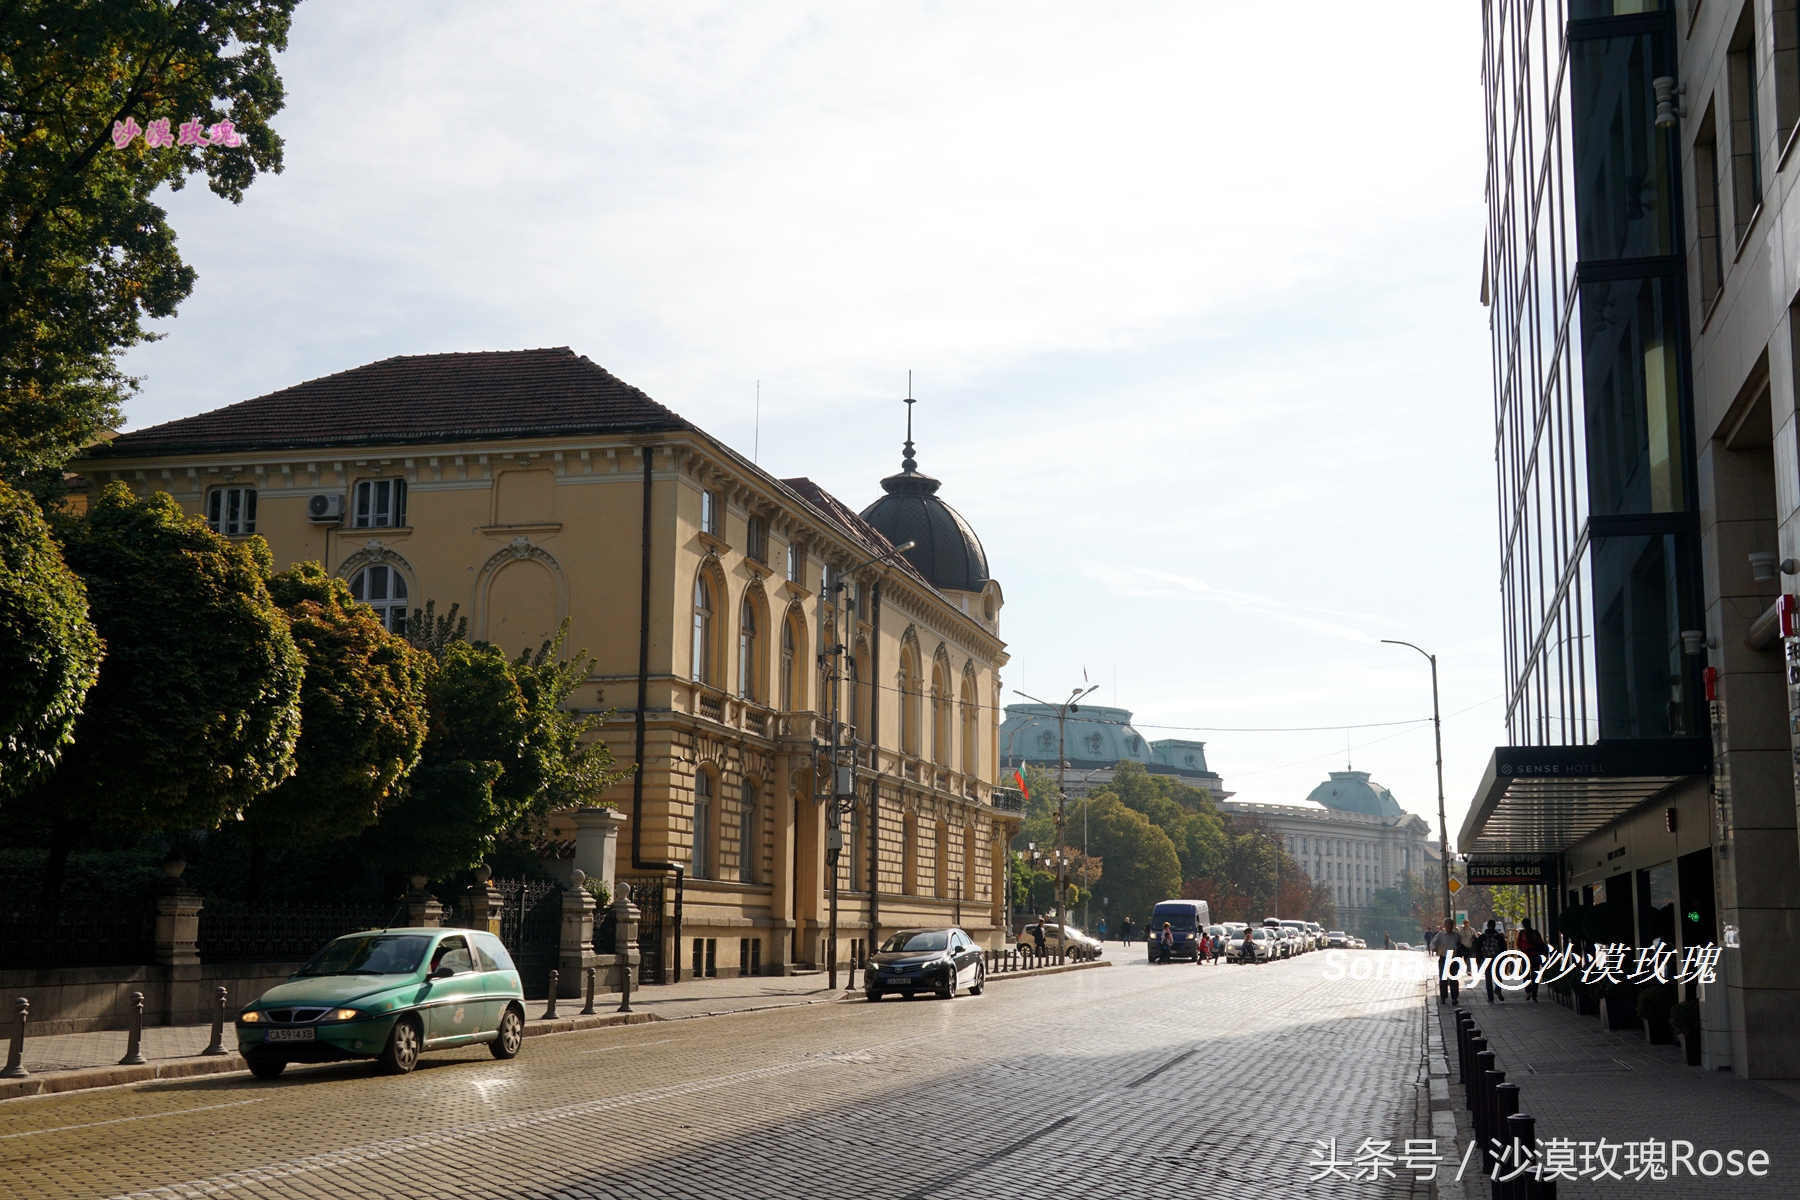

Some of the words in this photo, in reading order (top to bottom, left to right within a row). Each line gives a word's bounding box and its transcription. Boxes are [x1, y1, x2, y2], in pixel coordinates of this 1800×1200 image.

[1517, 765, 1560, 773] SENSE
[1566, 764, 1606, 773] HOTEL
[1470, 867, 1512, 876] FITNESS
[1514, 867, 1542, 876] CLUB
